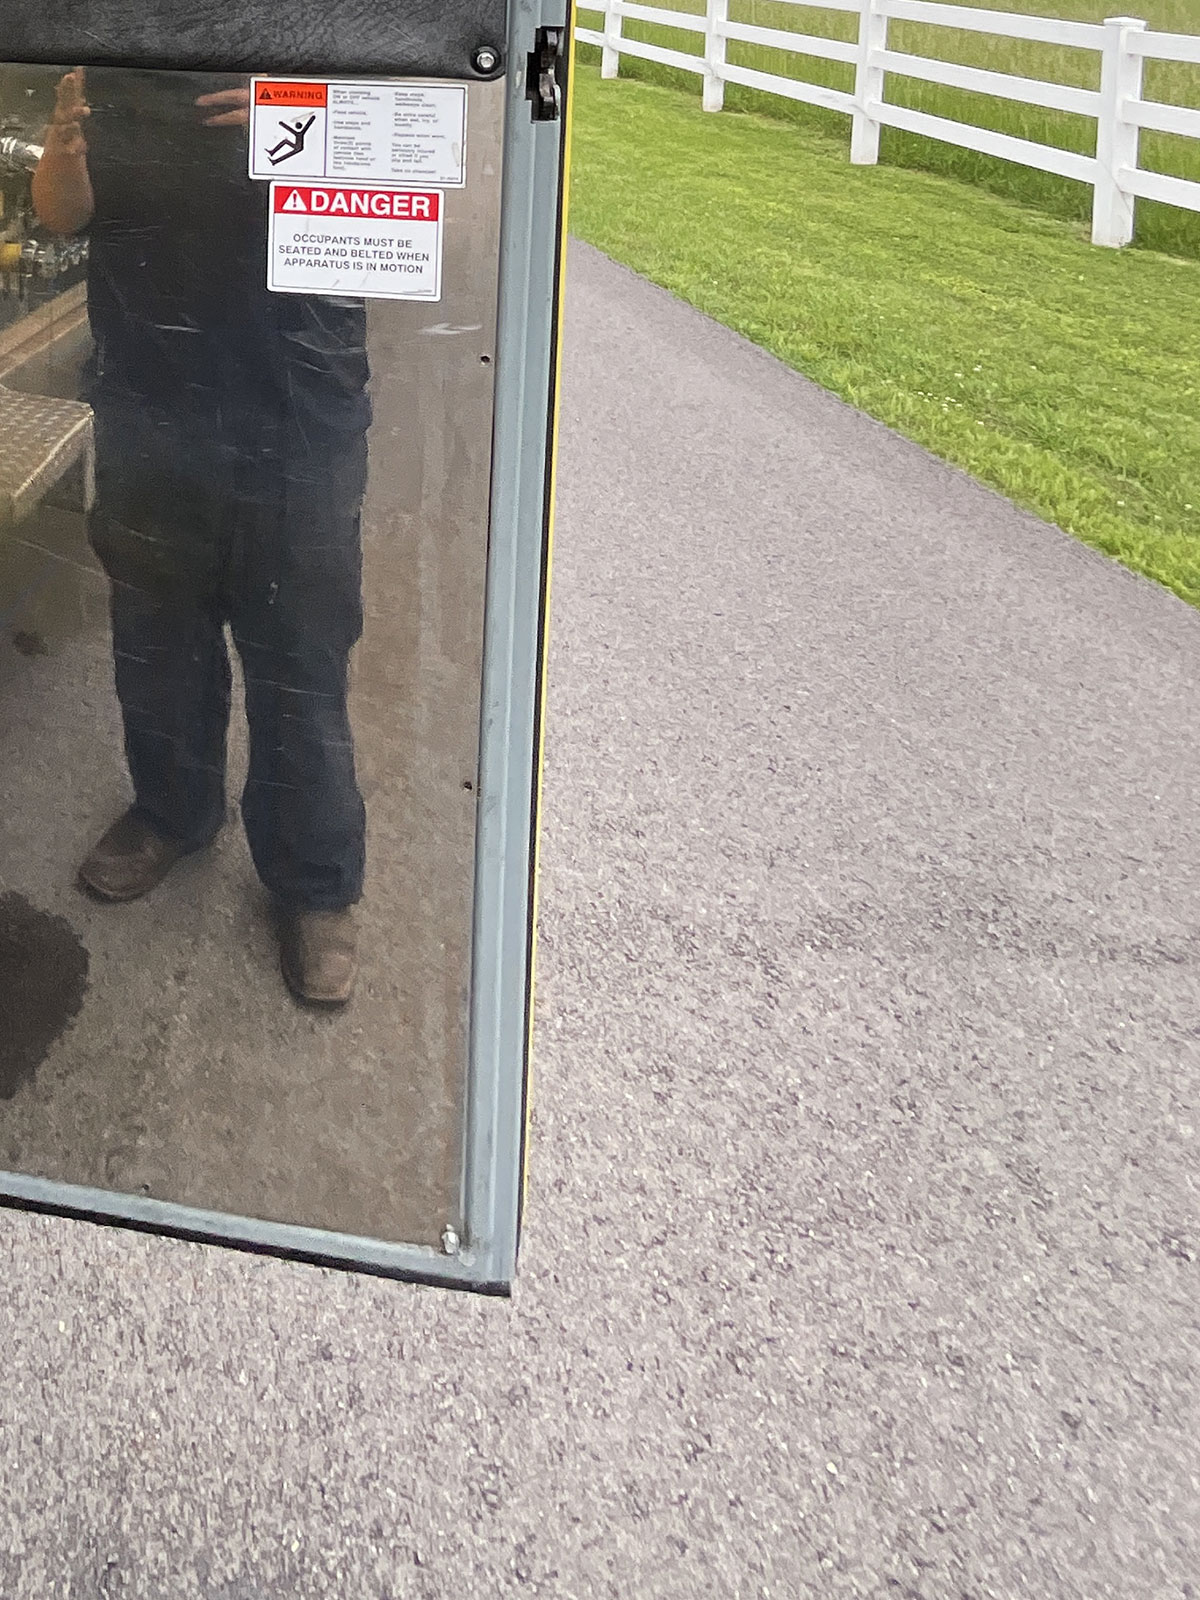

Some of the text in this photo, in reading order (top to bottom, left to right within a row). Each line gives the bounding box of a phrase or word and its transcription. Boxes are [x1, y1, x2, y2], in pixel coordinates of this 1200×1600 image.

[273, 89, 323, 100] WARNING
[310, 190, 430, 218] DANGER
[292, 233, 413, 248] OCCUPANTS MUST BE
[278, 245, 430, 262] SEATED AND BELTED WHEN
[283, 257, 424, 274] APPARATUS IS IN MOTION
